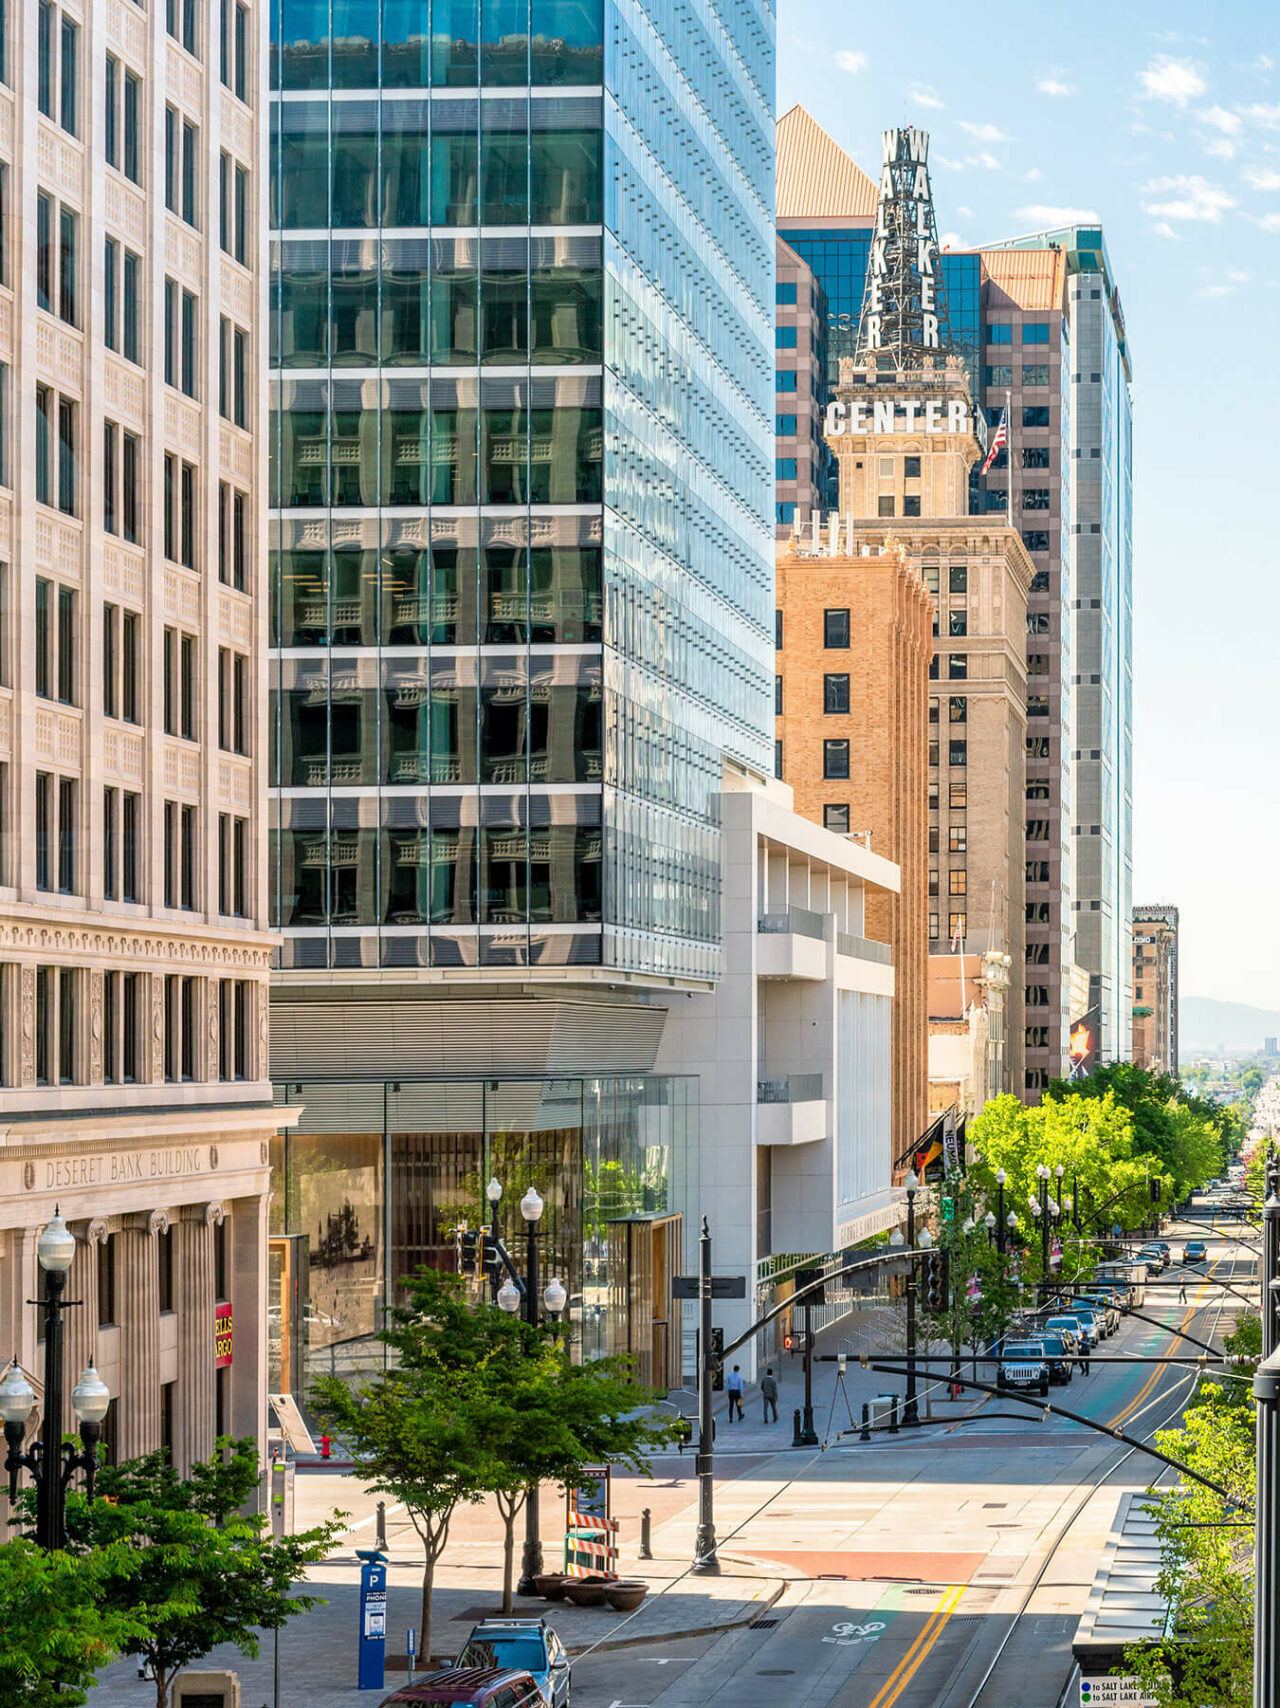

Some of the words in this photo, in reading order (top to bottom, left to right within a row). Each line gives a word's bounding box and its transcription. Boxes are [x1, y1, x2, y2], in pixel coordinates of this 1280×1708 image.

[868, 130, 900, 350] WALKER
[908, 129, 939, 349] WALKER
[826, 399, 968, 436] CENTER
[46, 1157, 103, 1188] DESERET
[111, 1154, 143, 1181] BANK
[150, 1149, 201, 1176] BUILDING
[215, 1316, 233, 1336] ELLS
[215, 1339, 233, 1359] ARGO
[369, 1575, 379, 1588] P
[1102, 1682, 1117, 1690] SALT
[1102, 1692, 1117, 1701] SALT
[1119, 1692, 1137, 1700] LAKE
